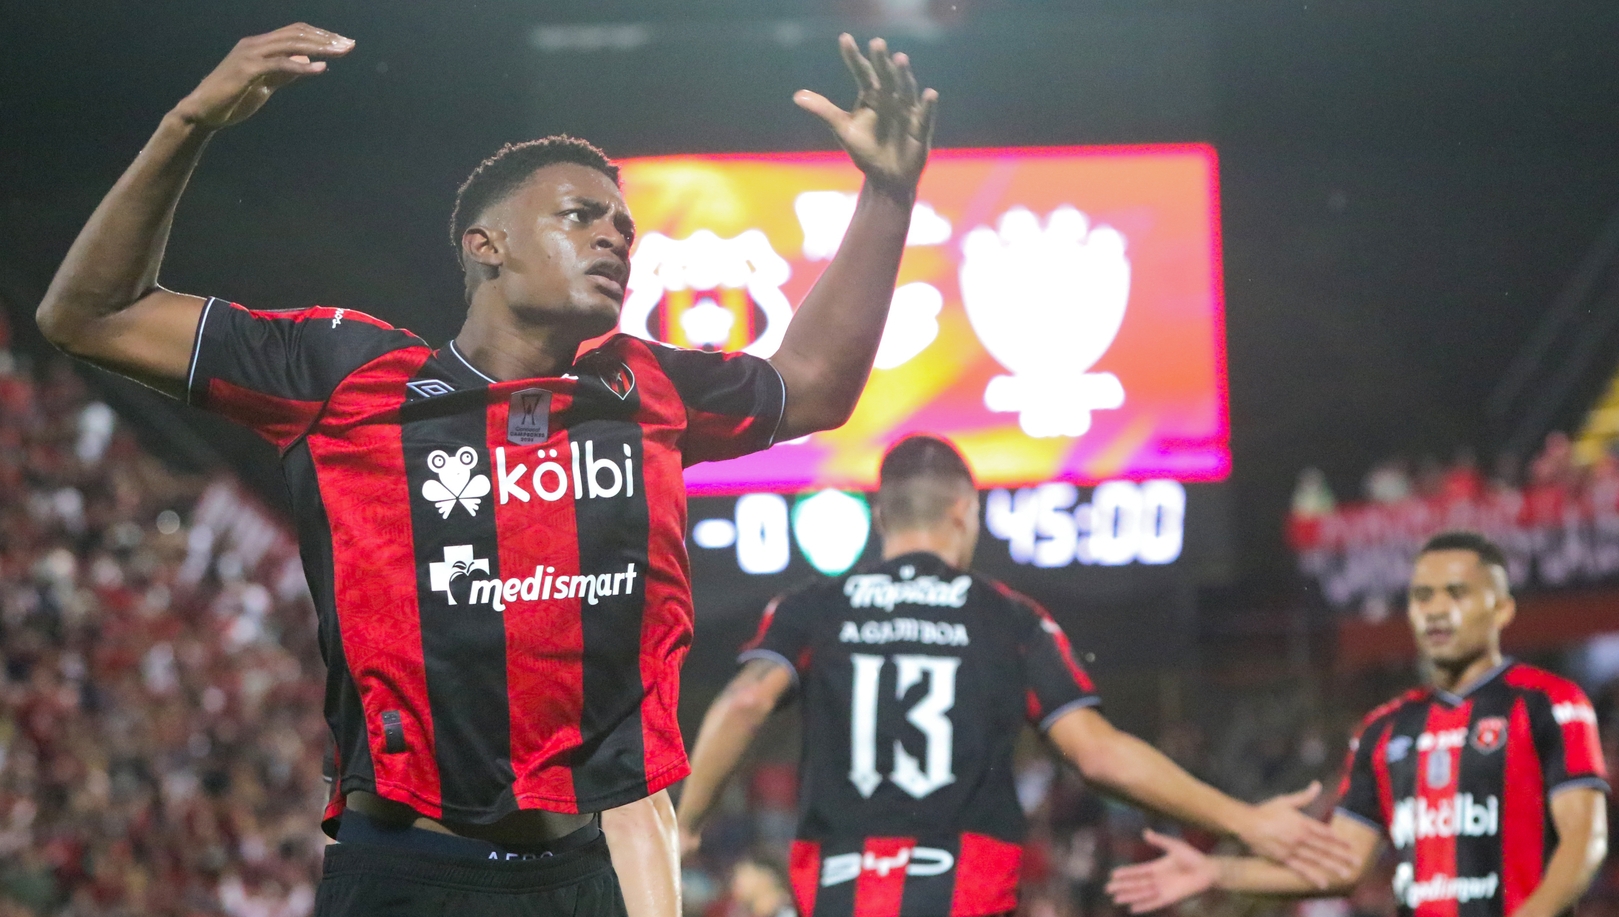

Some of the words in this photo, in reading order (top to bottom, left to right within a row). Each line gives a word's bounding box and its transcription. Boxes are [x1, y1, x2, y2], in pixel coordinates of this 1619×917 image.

[496, 440, 634, 505] kölbi
[986, 480, 1186, 567] 45:00
[468, 563, 637, 612] medismart
[848, 653, 961, 799] 13
[821, 847, 954, 887] BYD
